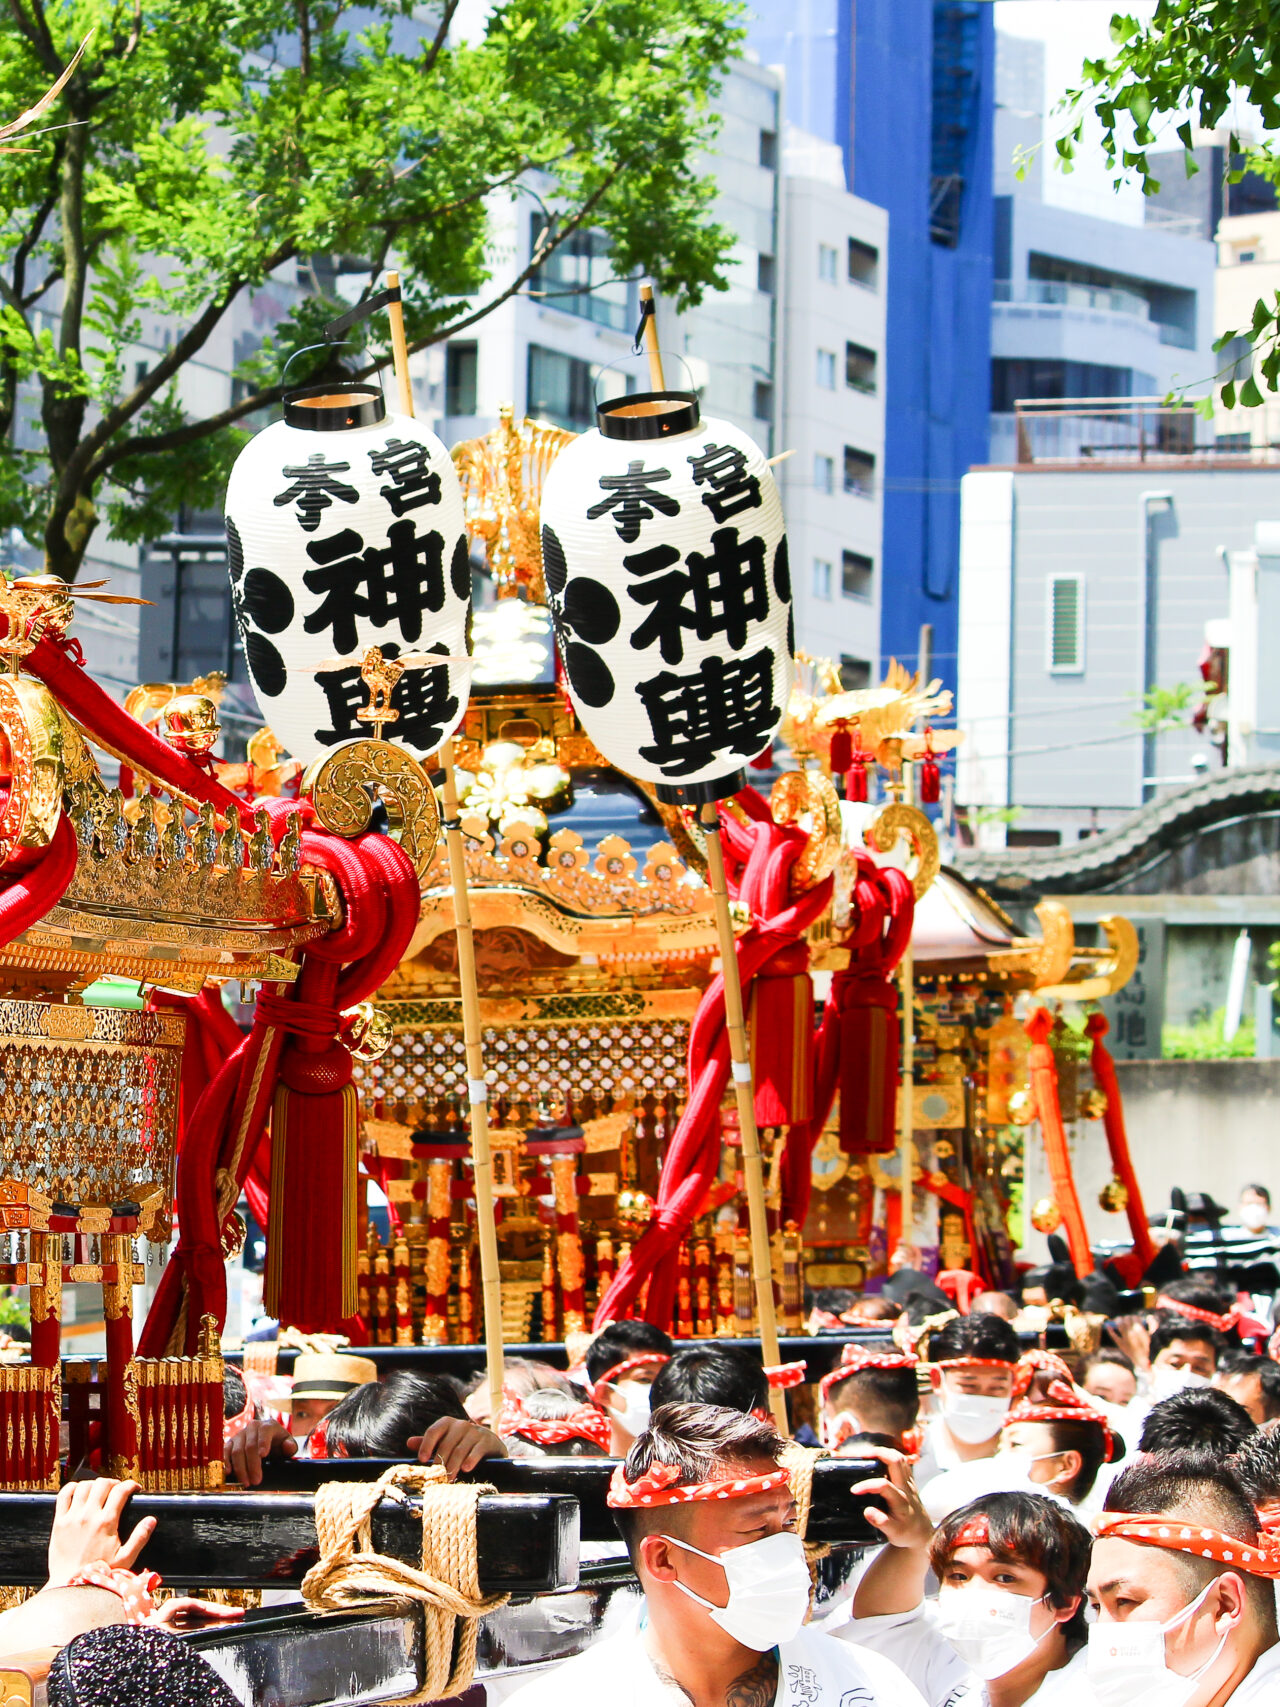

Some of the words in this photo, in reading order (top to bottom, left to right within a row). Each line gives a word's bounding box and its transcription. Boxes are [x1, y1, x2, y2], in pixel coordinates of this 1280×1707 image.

[273, 438, 442, 532] 宮本
[587, 443, 763, 543] 宮本
[623, 527, 782, 776] 神輿
